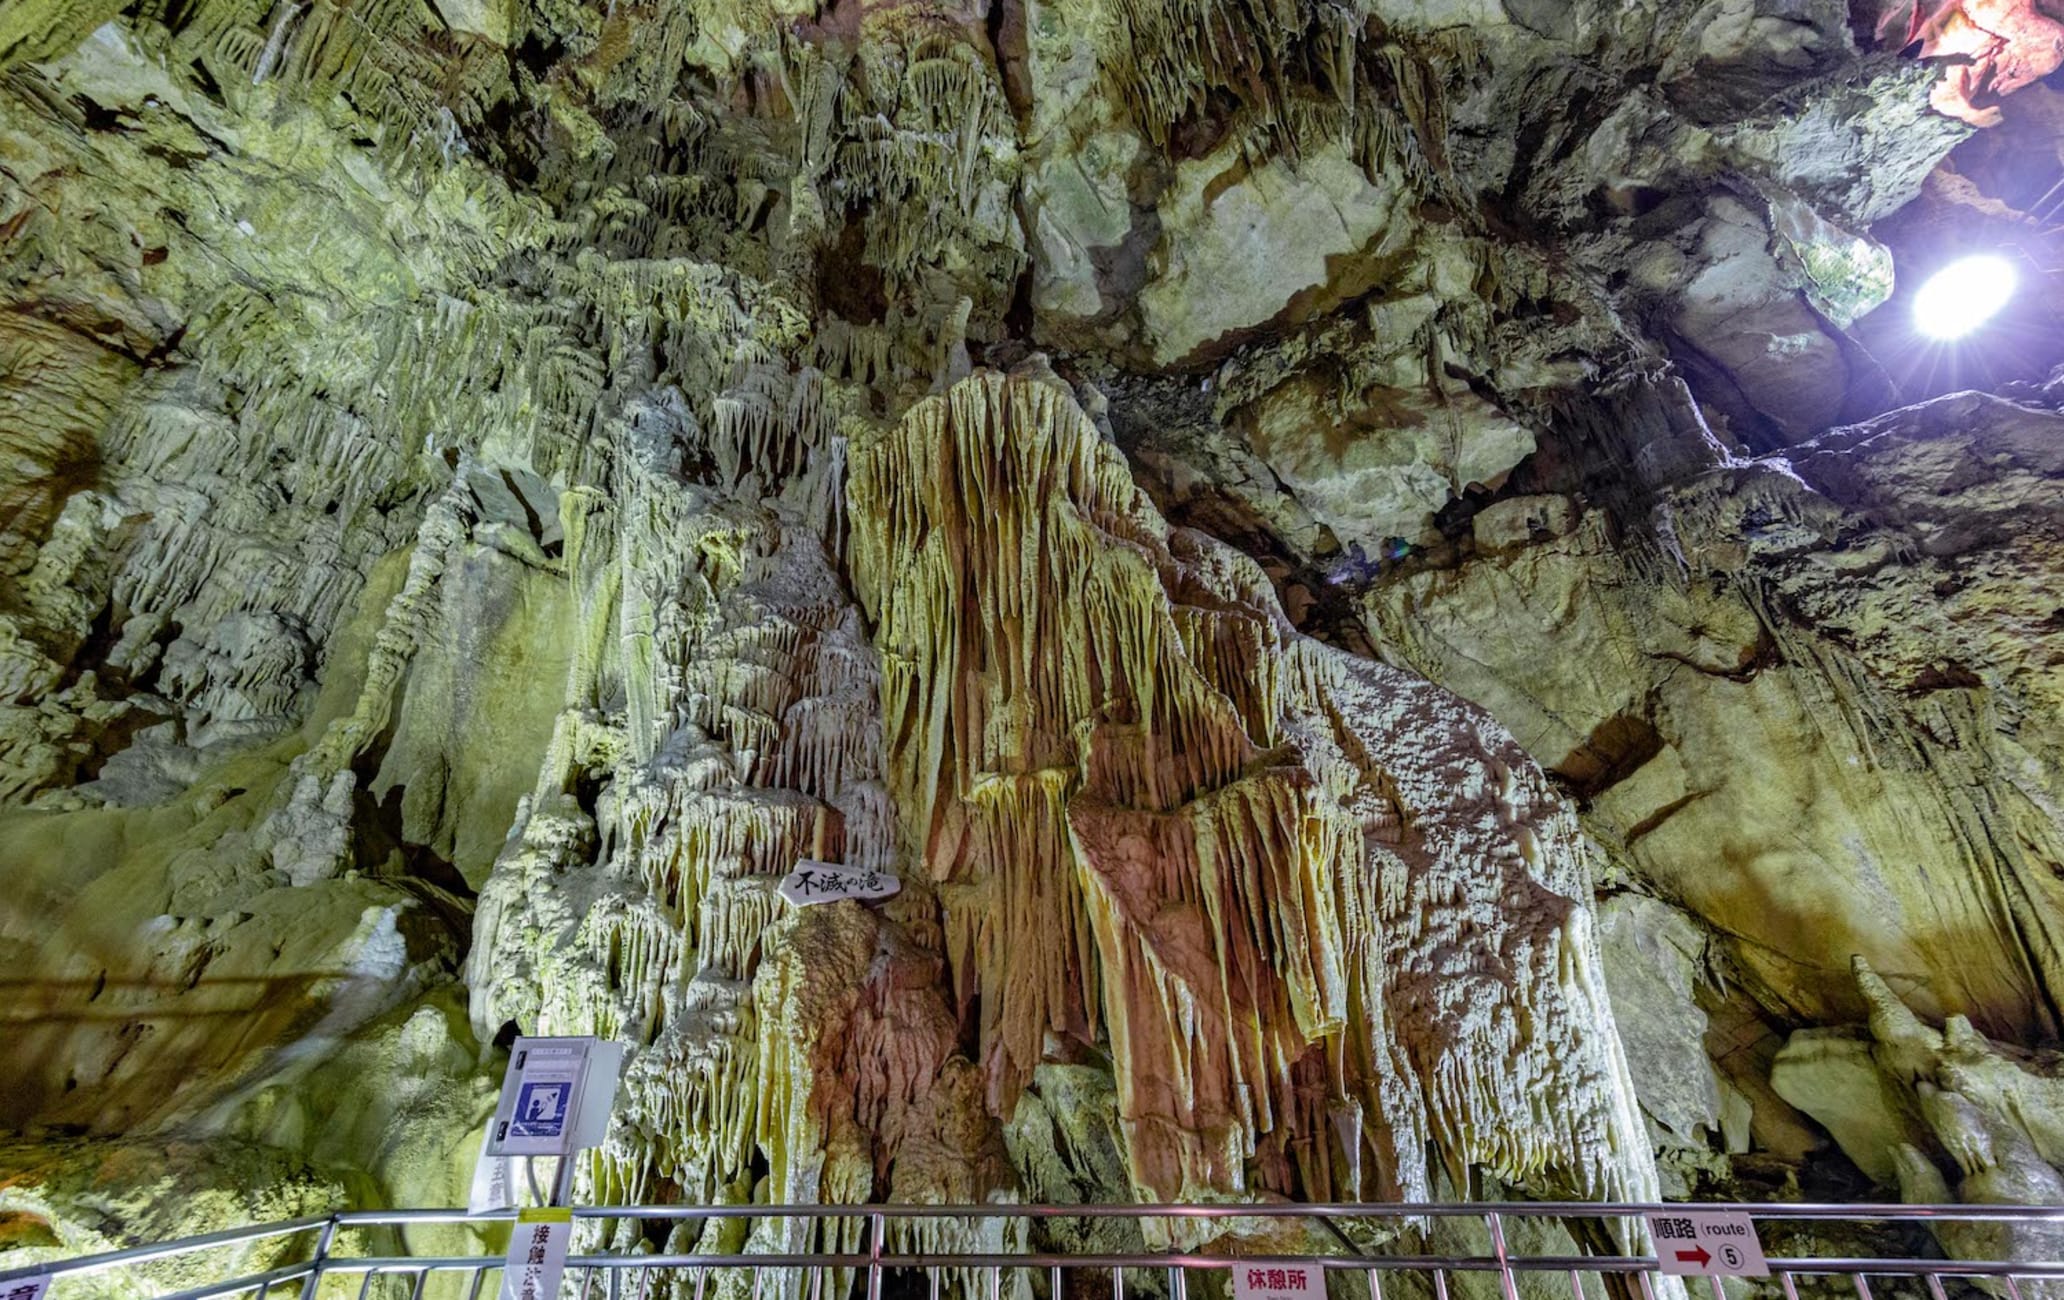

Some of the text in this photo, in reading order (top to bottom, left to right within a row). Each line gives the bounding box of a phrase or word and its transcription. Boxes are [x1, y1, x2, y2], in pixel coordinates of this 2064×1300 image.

[795, 870, 885, 895] 不滅の滝
[1652, 1217, 1751, 1239] 順路 (route)
[1247, 1268, 1307, 1290] 休憩所
